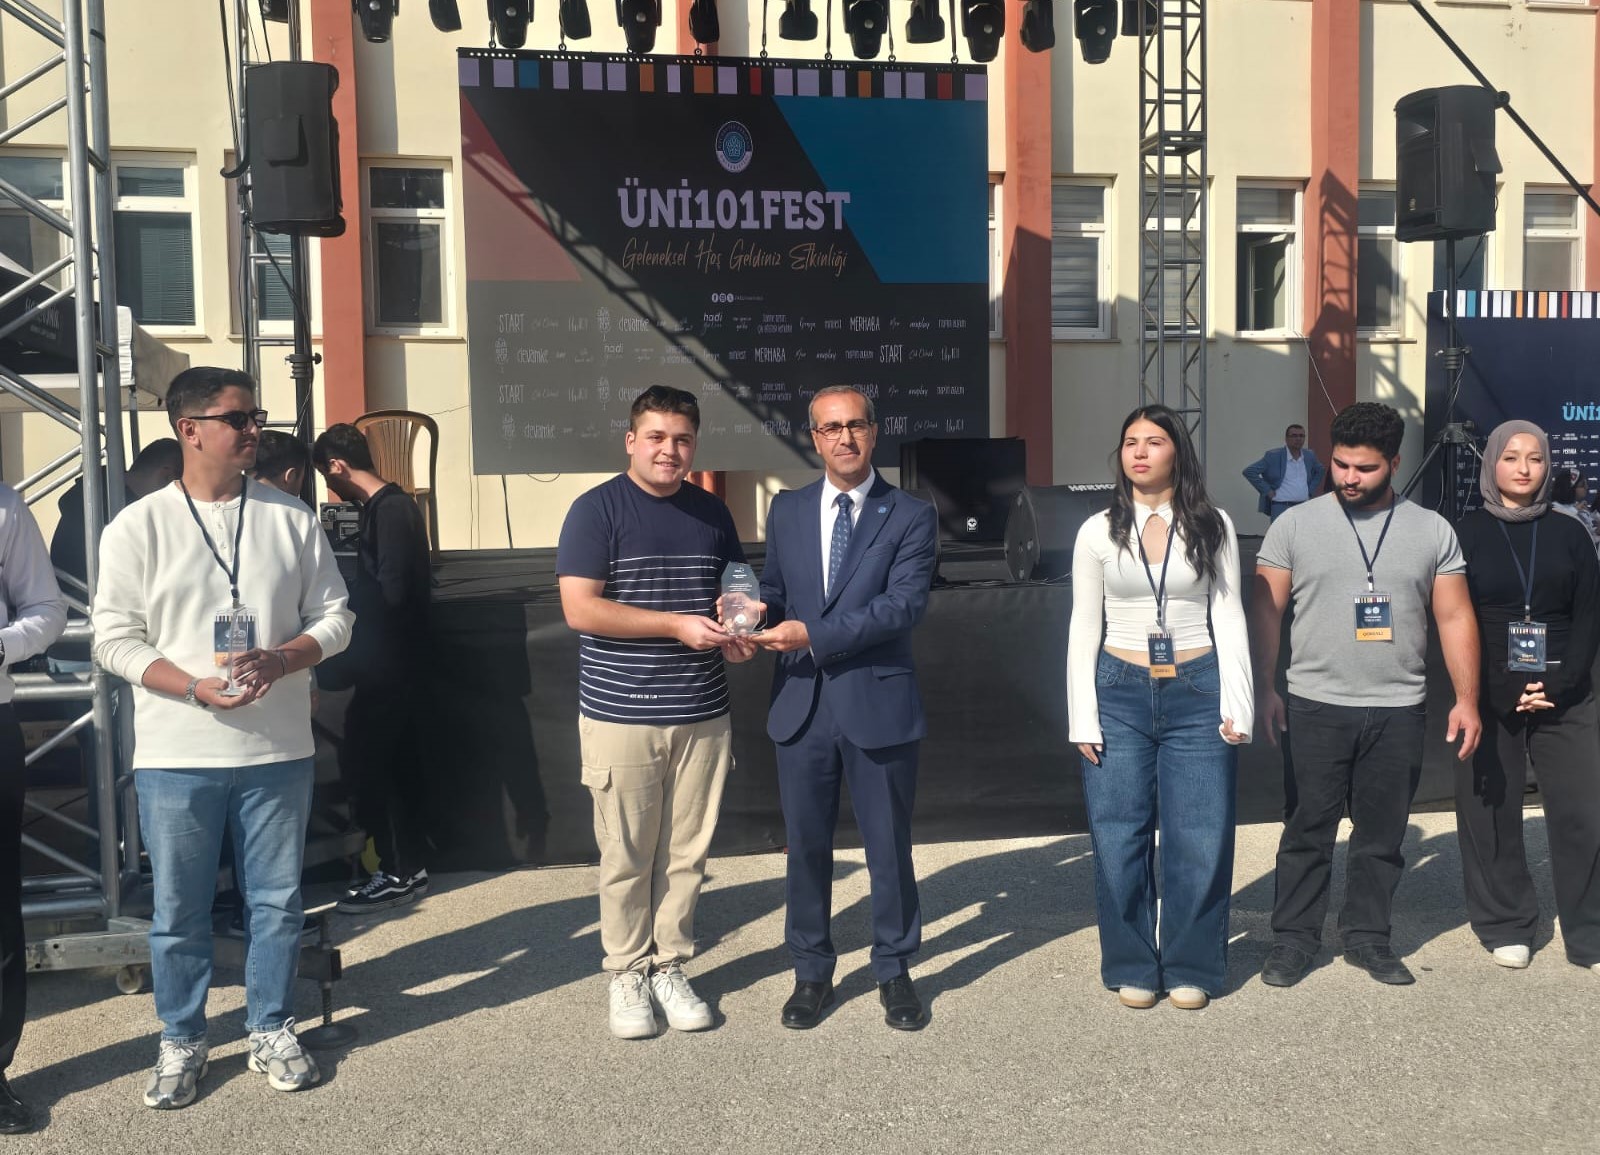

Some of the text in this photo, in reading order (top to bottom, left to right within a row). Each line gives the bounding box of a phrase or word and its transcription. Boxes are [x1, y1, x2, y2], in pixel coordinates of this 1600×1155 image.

[617, 177, 851, 230] ÜNİ101FEST
[622, 232, 848, 277] Geleneksel Hoş Geldiniz Etkinliği
[499, 313, 524, 334] START
[849, 315, 880, 332] MERHABA
[754, 346, 786, 363] MERHABA
[879, 344, 903, 364] START
[499, 384, 524, 404] START
[760, 420, 791, 436] MERHABA
[884, 416, 908, 435] START
